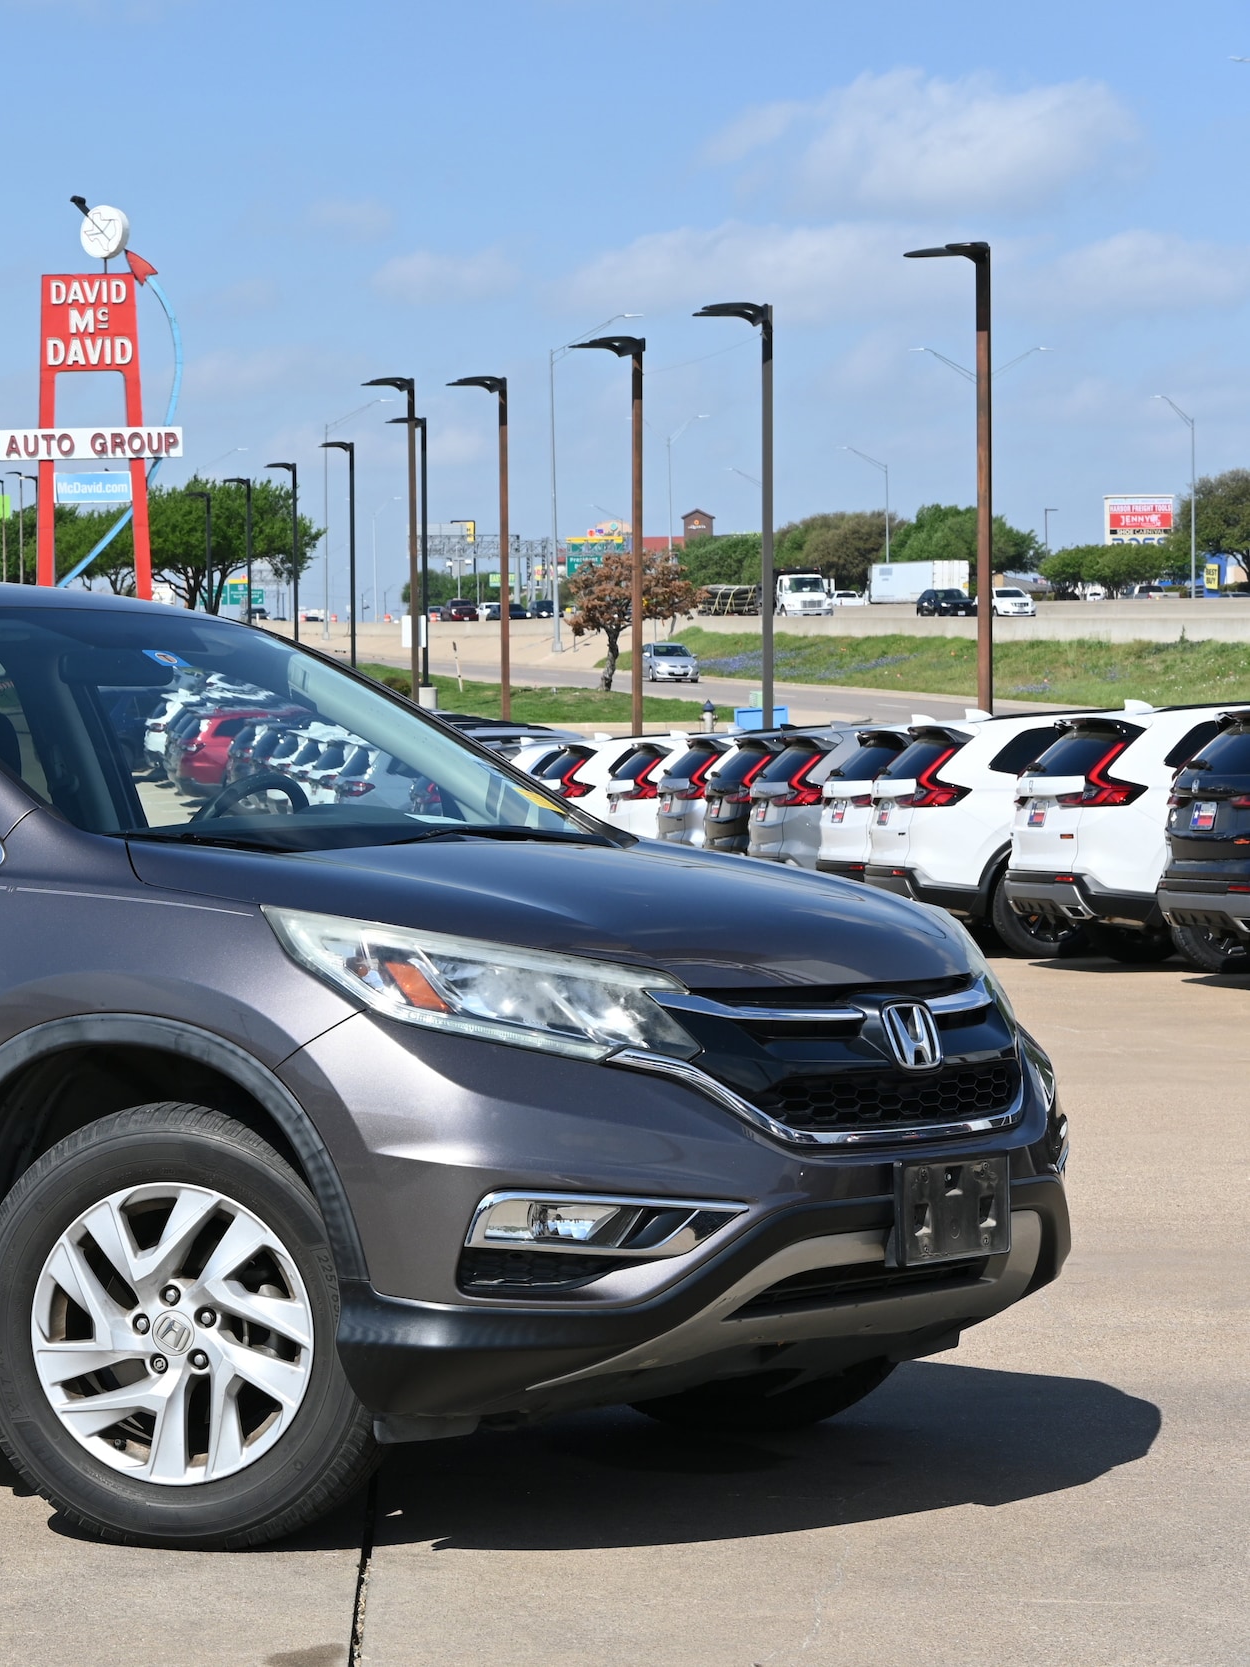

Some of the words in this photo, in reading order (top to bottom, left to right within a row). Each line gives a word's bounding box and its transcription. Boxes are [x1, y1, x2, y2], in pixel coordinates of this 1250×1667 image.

[50, 280, 127, 305] DAVID
[47, 337, 133, 366] DAVID
[6, 433, 75, 458] AUTO
[90, 432, 180, 455] GROUP
[57, 482, 128, 494] McDavid.com
[1206, 568, 1217, 576] BEST
